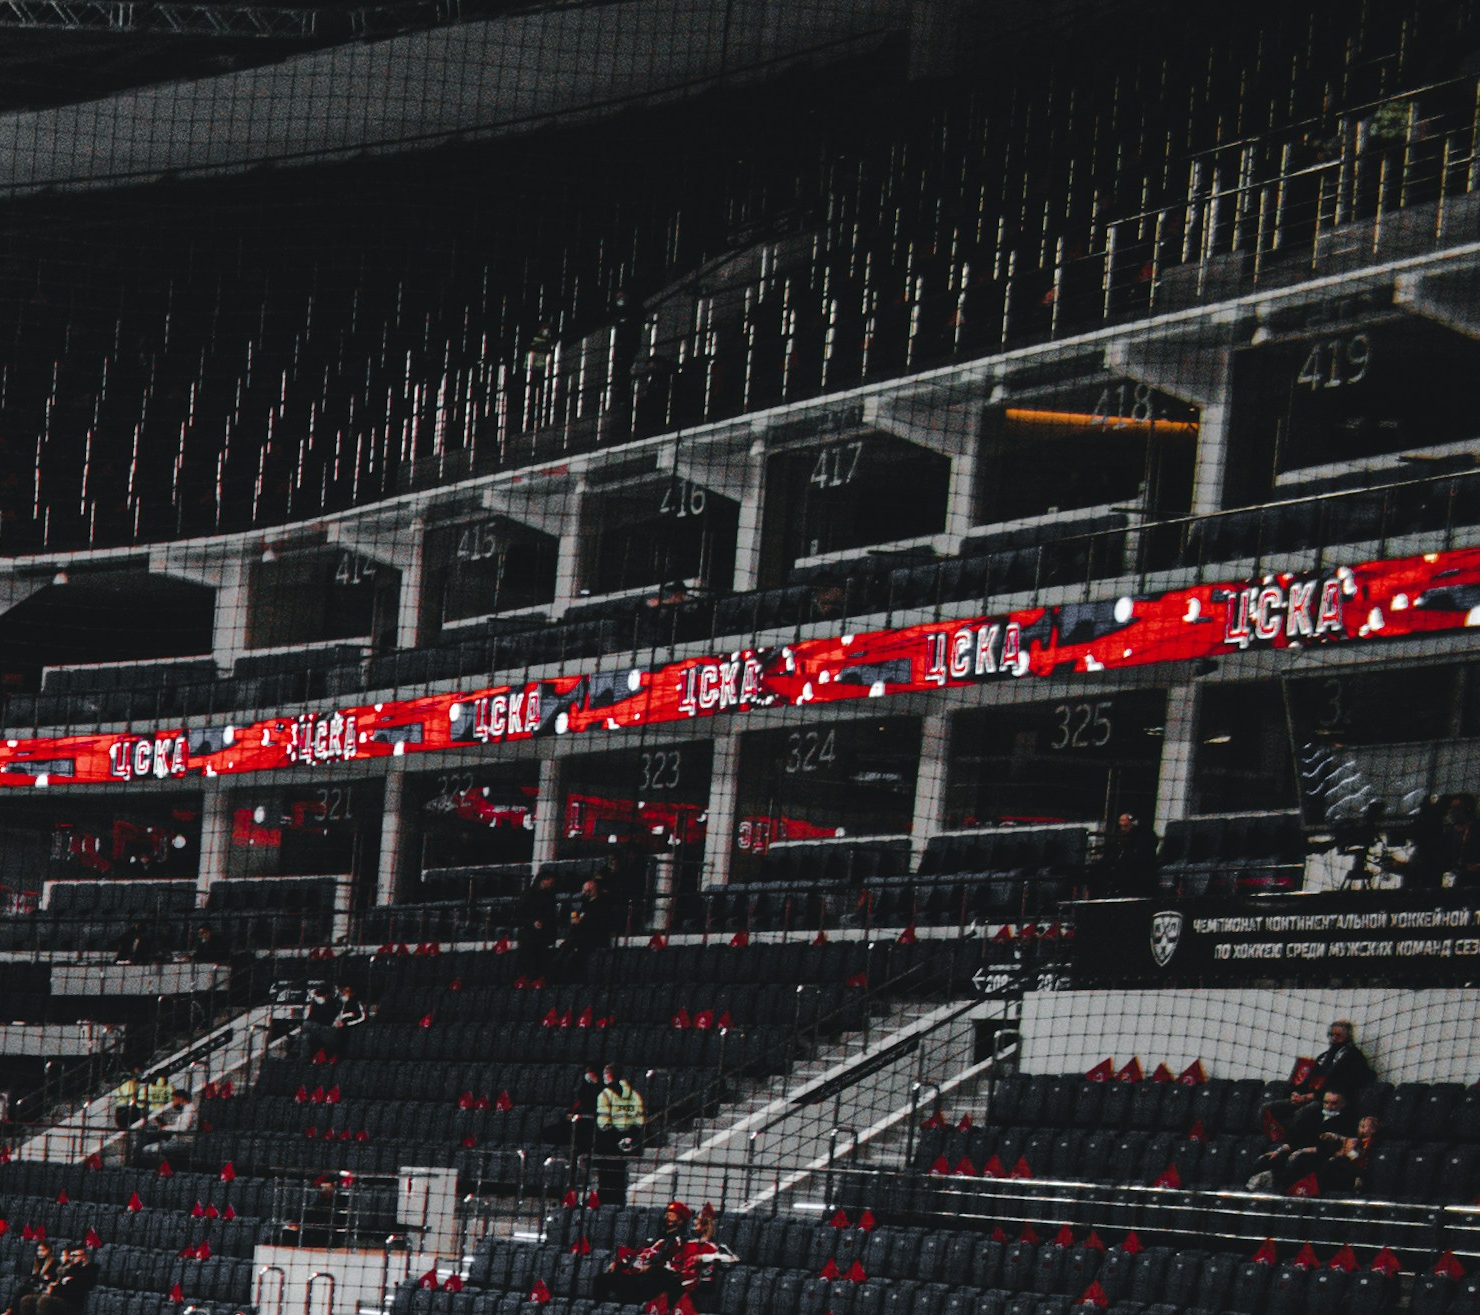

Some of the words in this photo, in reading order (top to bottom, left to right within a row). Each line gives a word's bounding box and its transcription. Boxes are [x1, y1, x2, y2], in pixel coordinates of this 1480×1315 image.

[1298, 335, 1372, 390] 419
[810, 441, 863, 490] 417
[457, 522, 500, 561] 415
[333, 553, 377, 589] 414
[1224, 575, 1348, 650] ЦСКА
[925, 620, 1026, 688] ЦСКА
[679, 650, 764, 716] ЦСКА
[473, 682, 546, 741] ЦСКА
[1050, 702, 1114, 752] 325
[110, 732, 188, 781] ЦСКА
[639, 751, 682, 791] 323
[785, 728, 837, 775] 324
[314, 786, 354, 822] 321
[1454, 938, 1480, 958] СЕЗ
